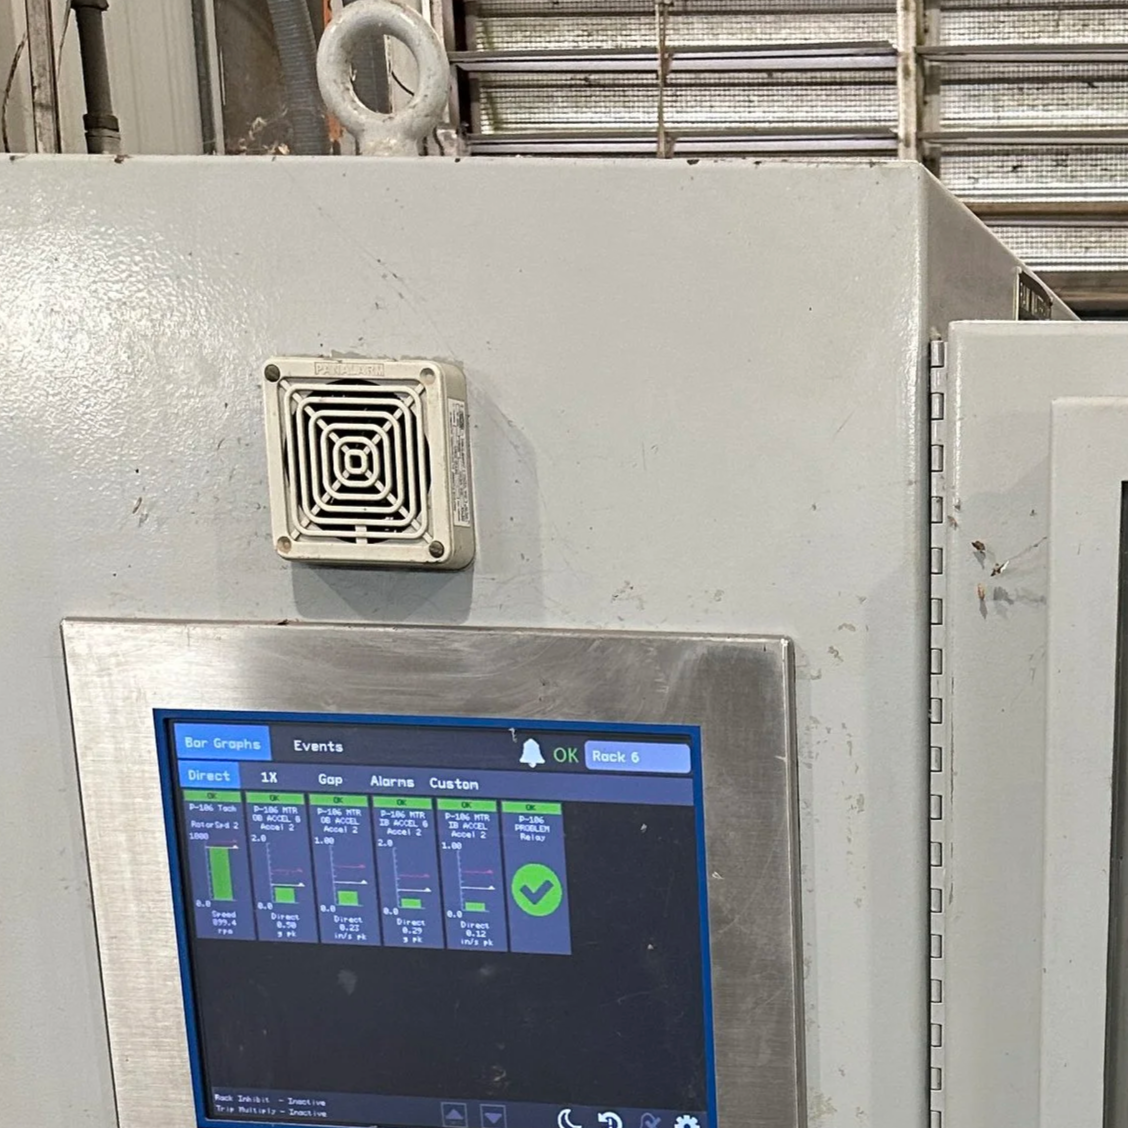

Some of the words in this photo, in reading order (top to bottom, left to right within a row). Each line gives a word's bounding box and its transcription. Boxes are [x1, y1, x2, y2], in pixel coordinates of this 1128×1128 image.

[184, 736, 208, 748] Bar
[213, 737, 261, 750] Graphs
[293, 740, 344, 753] Events
[553, 748, 579, 764] OK
[592, 750, 626, 763] Rack
[631, 752, 640, 764] 6
[188, 770, 230, 782] Direct
[260, 772, 278, 784] 1X
[318, 774, 343, 787] Gap
[370, 775, 415, 788] Alarms
[429, 777, 479, 790] Custom
[251, 834, 266, 842] 2.0
[520, 834, 546, 842] Relay
[288, 1098, 326, 1106] Inactive
[289, 1108, 327, 1118] Inactive
